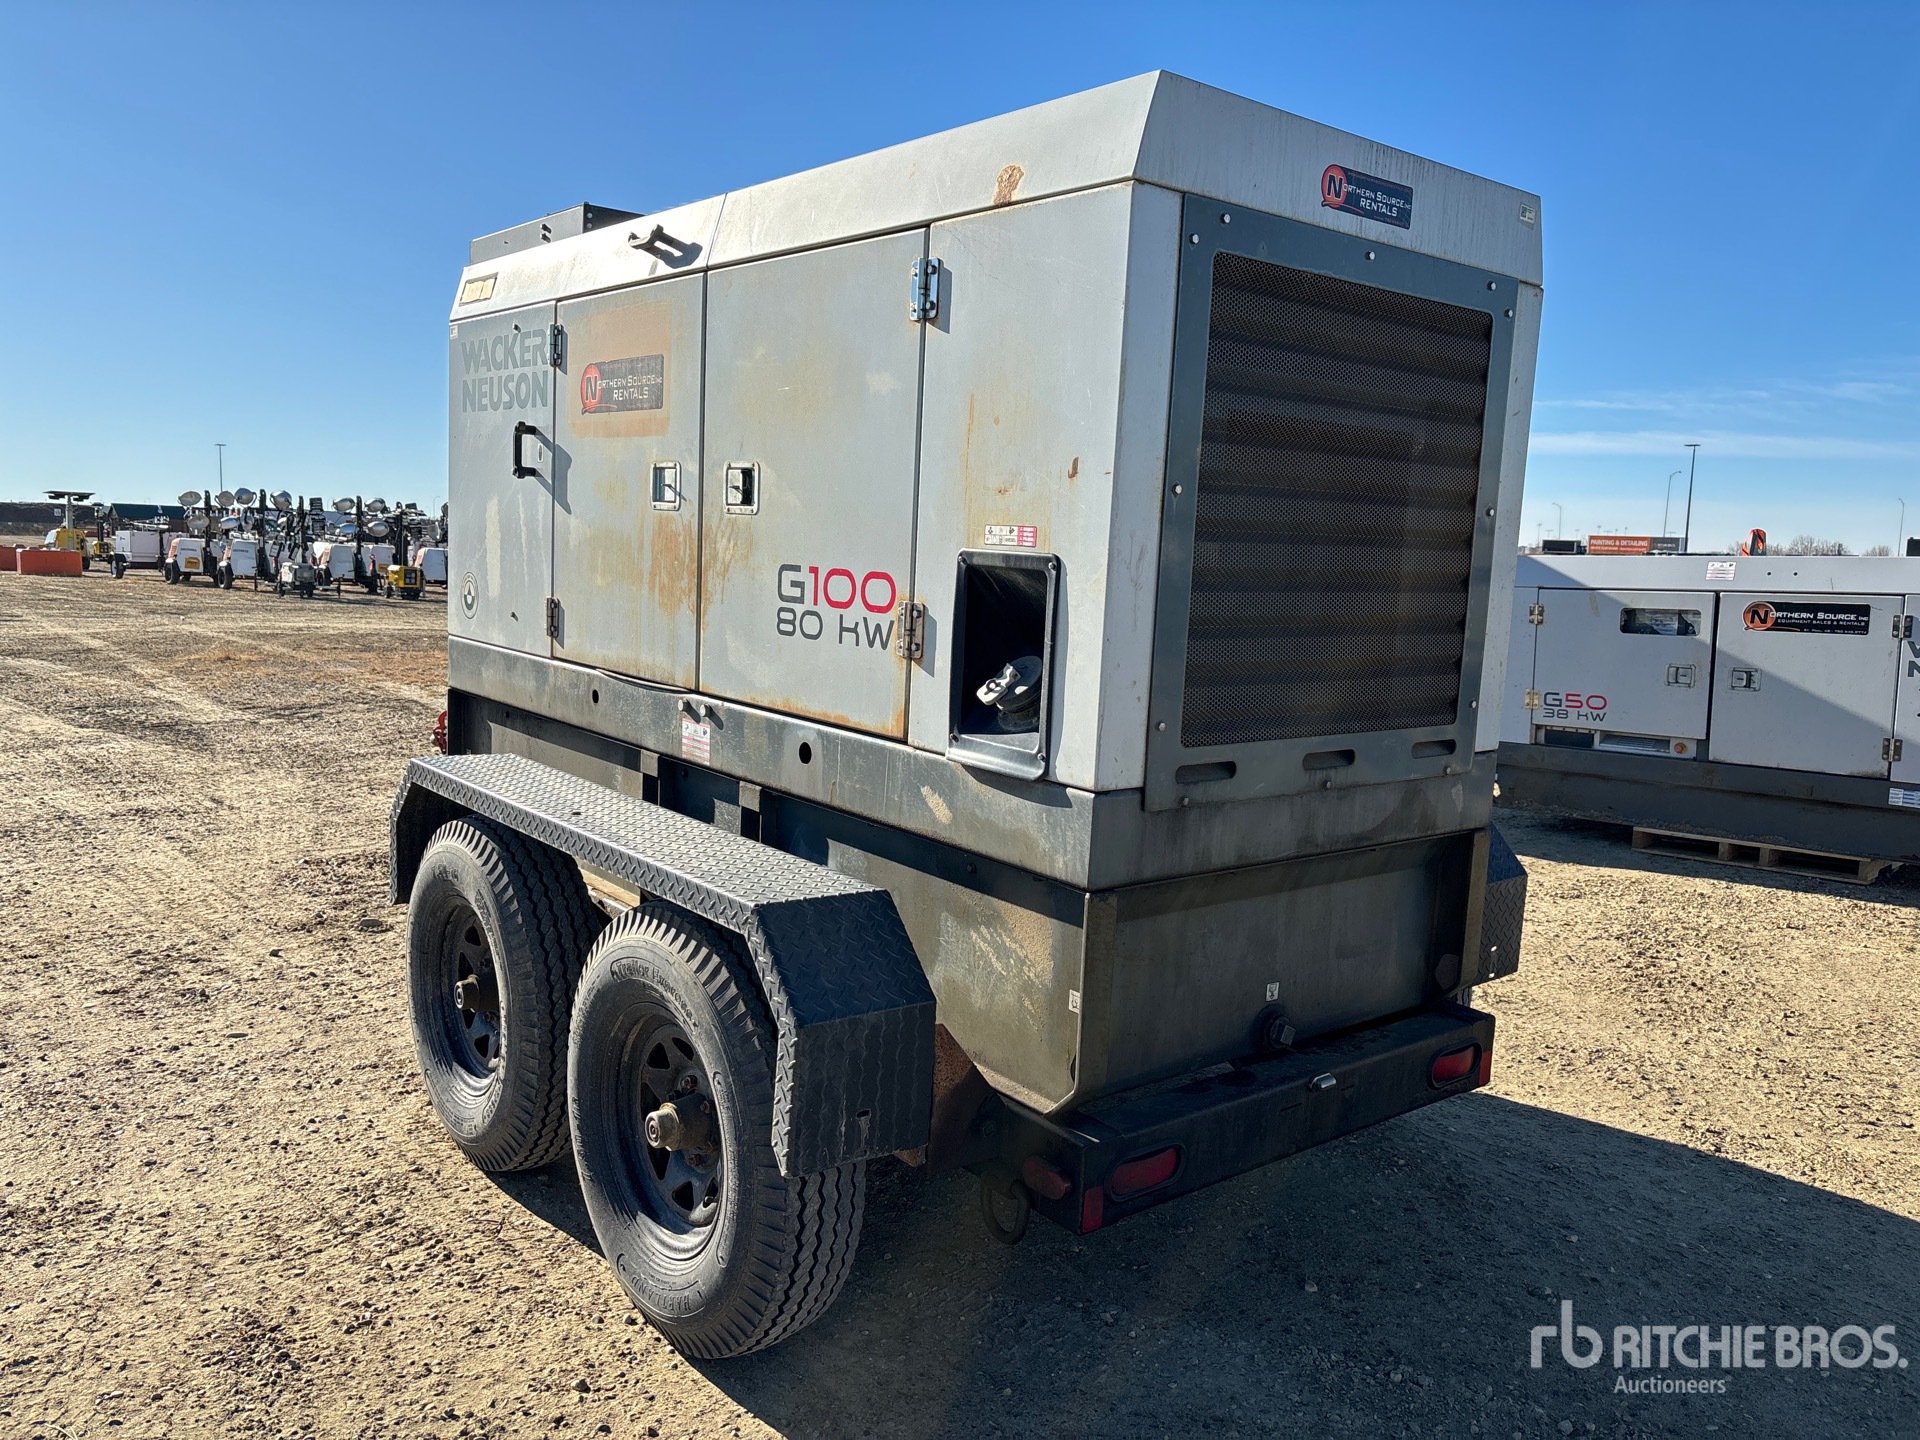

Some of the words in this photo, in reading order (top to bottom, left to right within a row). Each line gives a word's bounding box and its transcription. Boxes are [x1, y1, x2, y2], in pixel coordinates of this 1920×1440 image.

[1327, 173, 1376, 200] NORTHERN
[1376, 191, 1404, 209] SOURCE
[1360, 198, 1398, 217] RENTALS
[461, 328, 549, 375] WACKER
[462, 370, 549, 413] NEUSON
[584, 375, 627, 402] NORTHERN
[627, 375, 655, 386] SOURCE
[613, 387, 649, 400] RENTALS
[777, 563, 897, 614] G100
[776, 606, 823, 641] 80
[1749, 609, 1814, 624] NORTHERN
[1816, 611, 1857, 621] SOURCE
[1543, 692, 1607, 710] G50
[1543, 707, 1569, 719] 38
